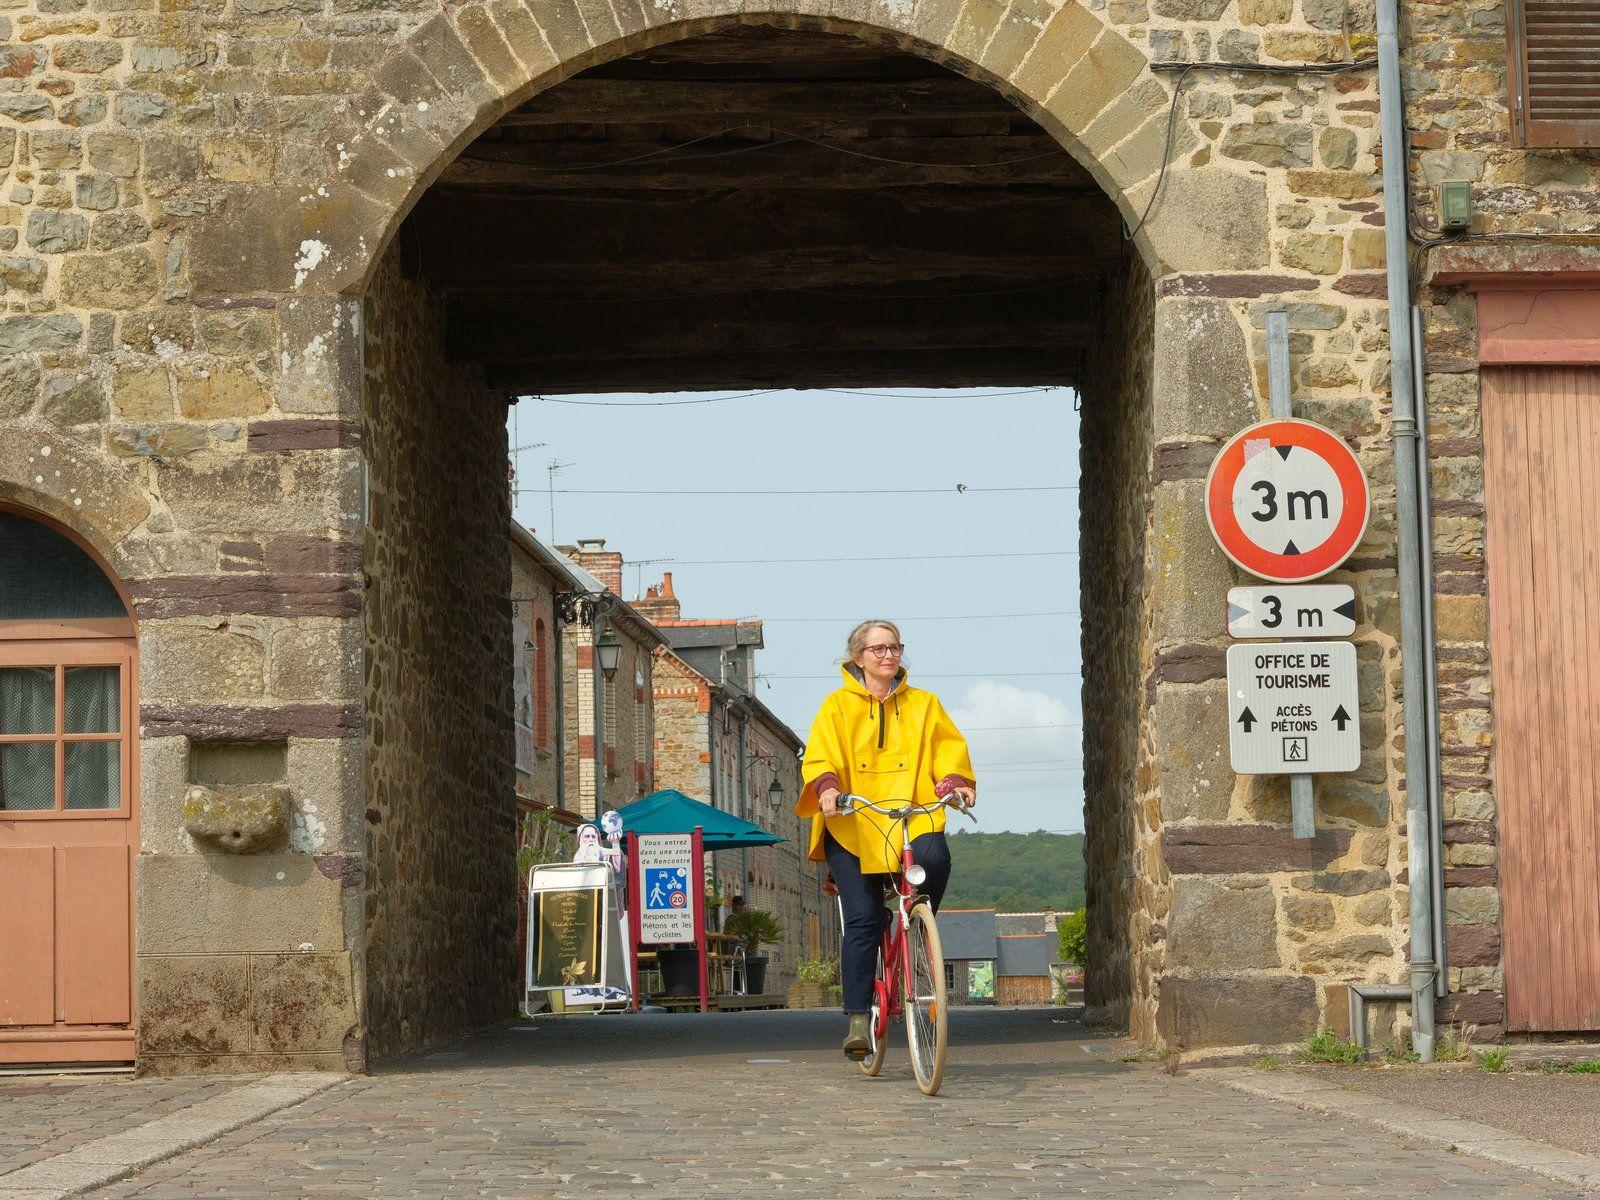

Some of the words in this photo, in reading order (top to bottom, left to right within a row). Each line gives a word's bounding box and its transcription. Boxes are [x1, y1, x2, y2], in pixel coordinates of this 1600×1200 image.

[1251, 480, 1278, 522] 3
[1287, 490, 1329, 521] m
[1261, 595, 1283, 628] 3
[1297, 608, 1323, 627] m
[1255, 655, 1305, 669] OFFICE
[1310, 654, 1330, 668] DE
[1256, 674, 1330, 689] TOURISME
[1276, 703, 1312, 717] ACCÈS
[1271, 719, 1318, 732] PIÉTONS
[643, 913, 678, 921] Respectez
[642, 922, 668, 930] Piétons
[653, 932, 682, 940] Cyclistes
